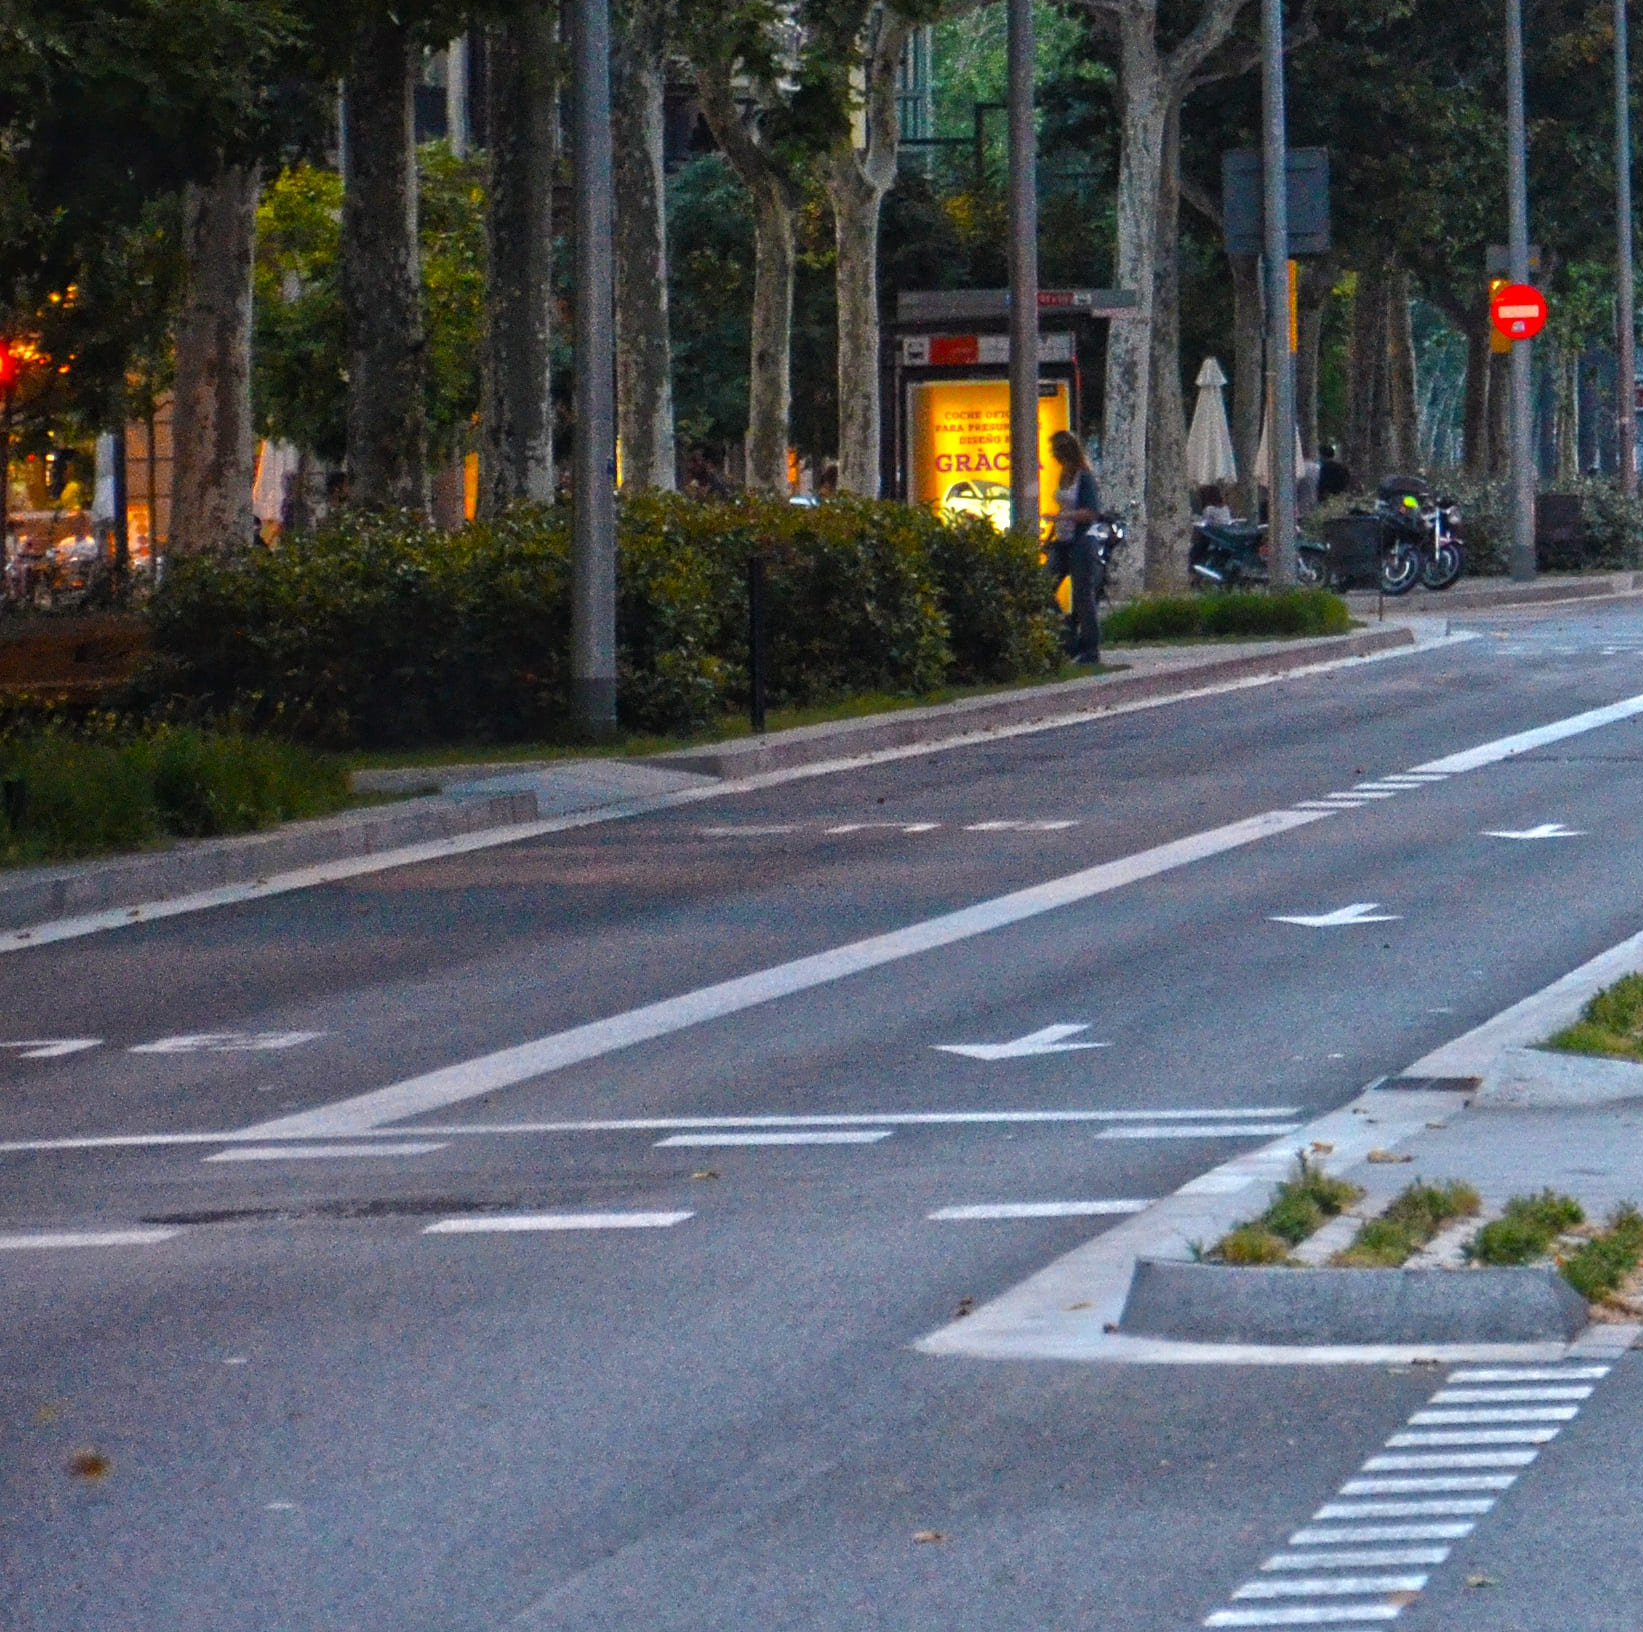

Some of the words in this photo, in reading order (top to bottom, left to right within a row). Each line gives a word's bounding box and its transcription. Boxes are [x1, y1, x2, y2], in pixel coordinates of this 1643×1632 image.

[944, 410, 982, 420] COCHE
[935, 423, 964, 432] PARA
[960, 433, 1001, 445] DISEÑO
